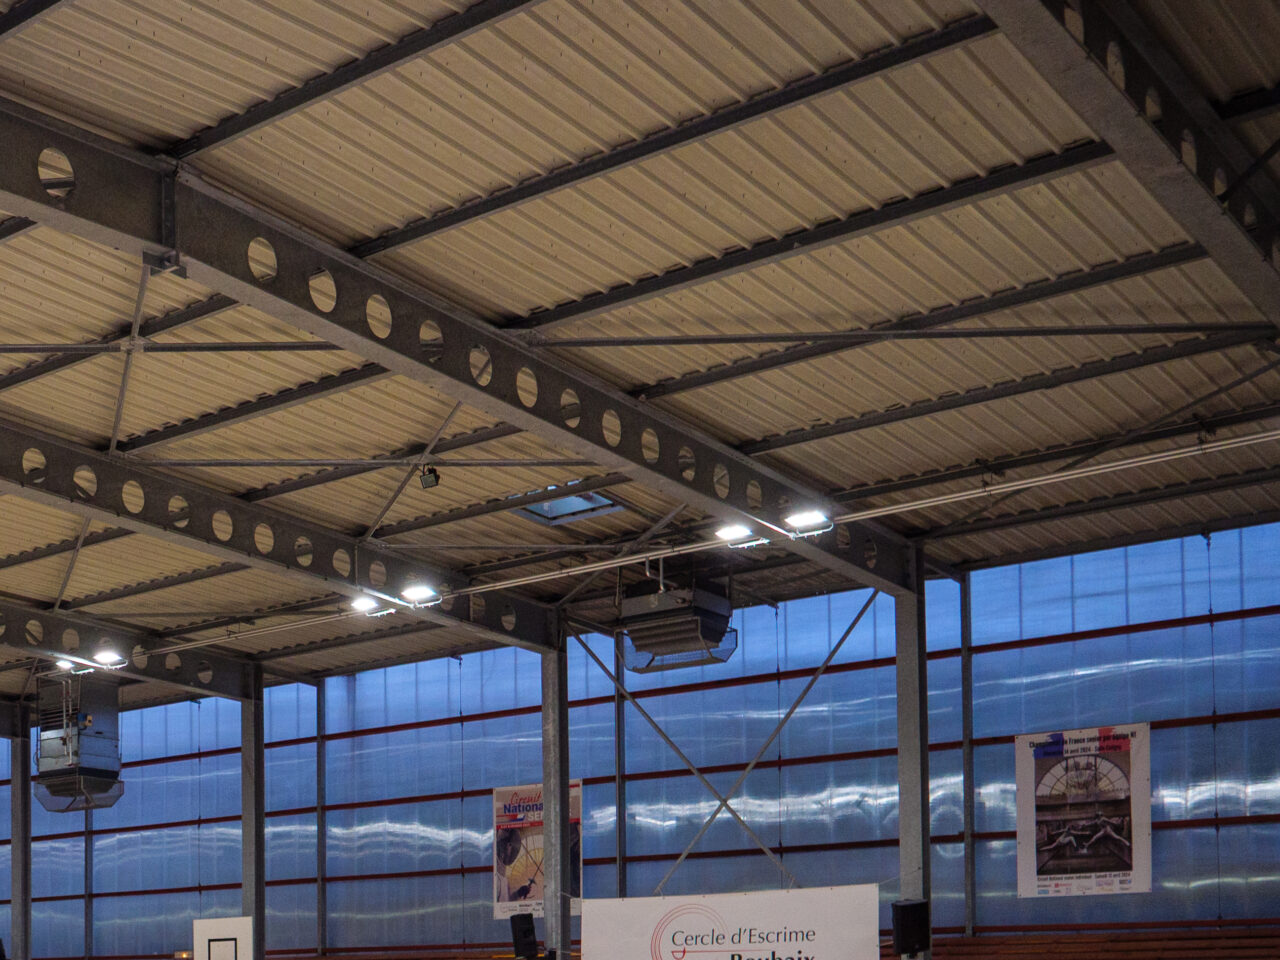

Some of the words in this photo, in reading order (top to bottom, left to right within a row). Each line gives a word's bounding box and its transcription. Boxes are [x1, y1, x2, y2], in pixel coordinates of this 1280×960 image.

[503, 802, 543, 814] Nationa
[671, 928, 726, 946] Cercle
[731, 926, 816, 945] d'Escrime
